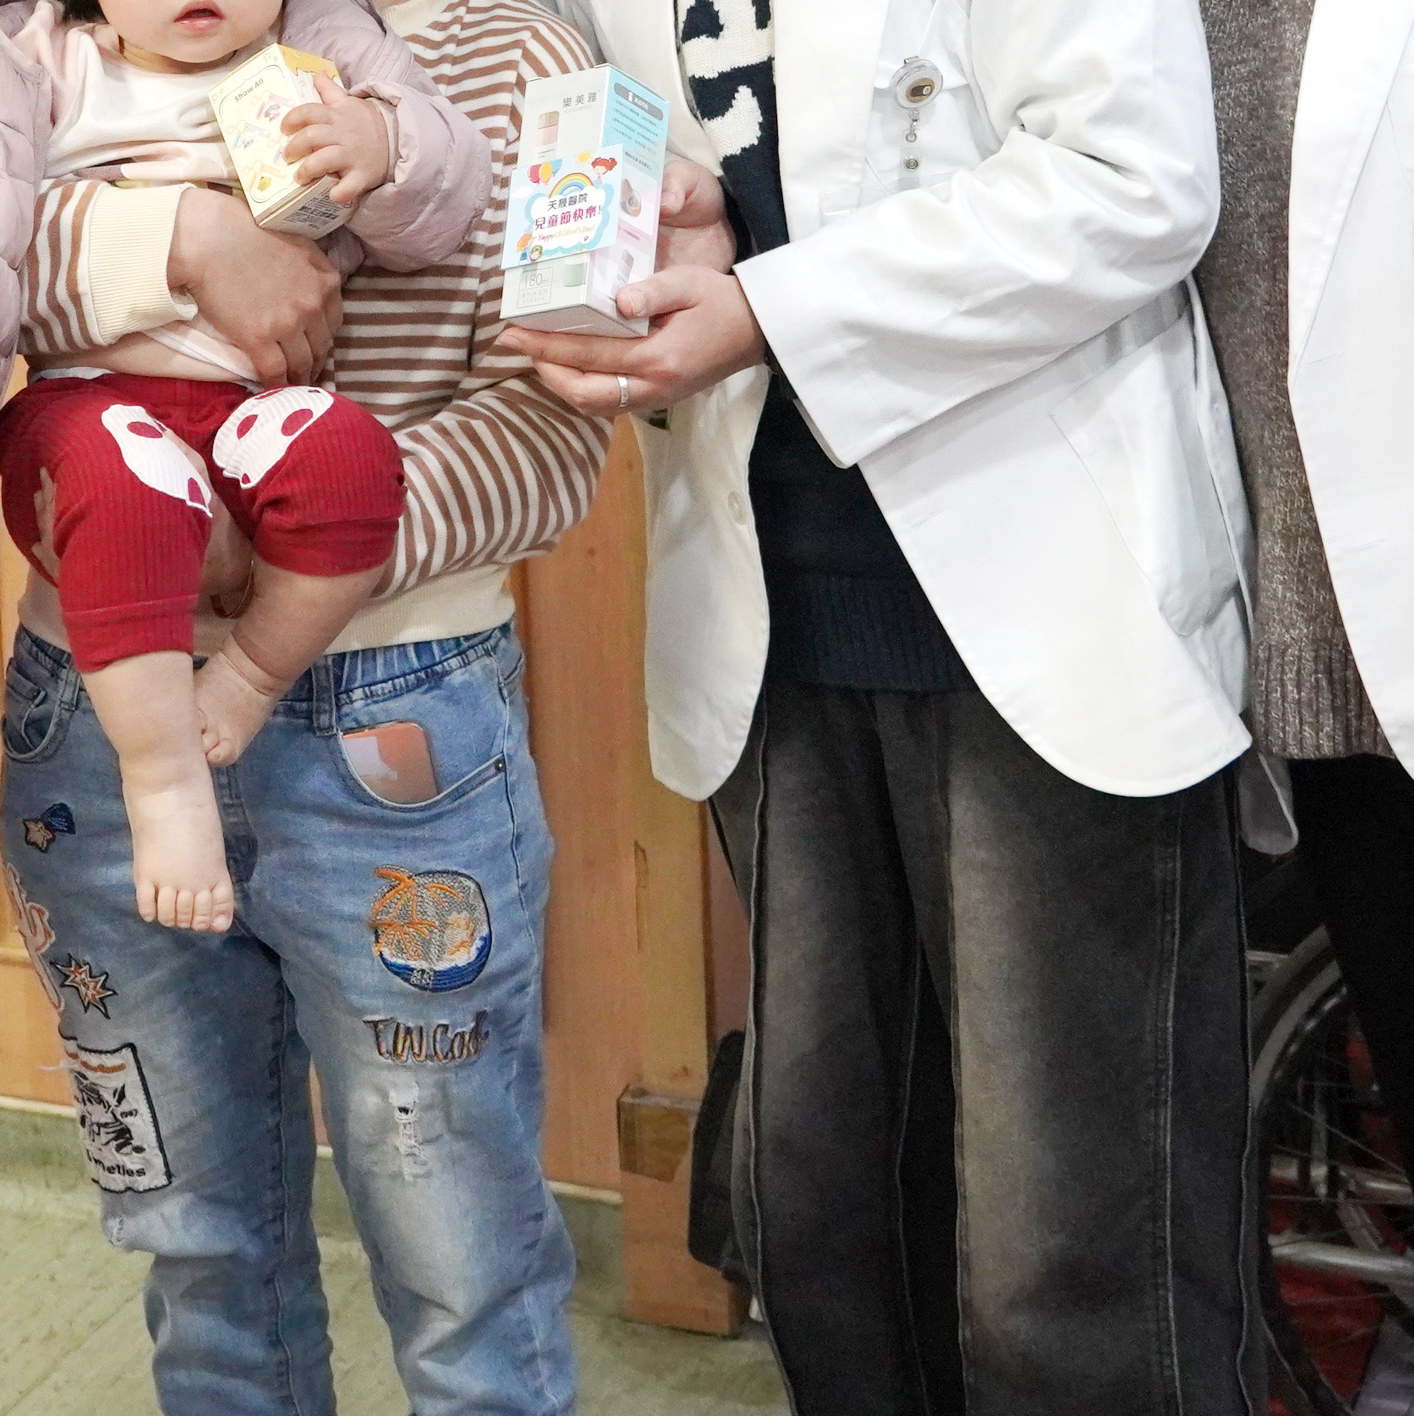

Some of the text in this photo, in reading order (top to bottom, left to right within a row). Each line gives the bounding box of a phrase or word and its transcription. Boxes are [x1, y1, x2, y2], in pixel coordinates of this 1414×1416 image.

[234, 85, 255, 103] Show
[548, 193, 588, 211] 天晟醫院
